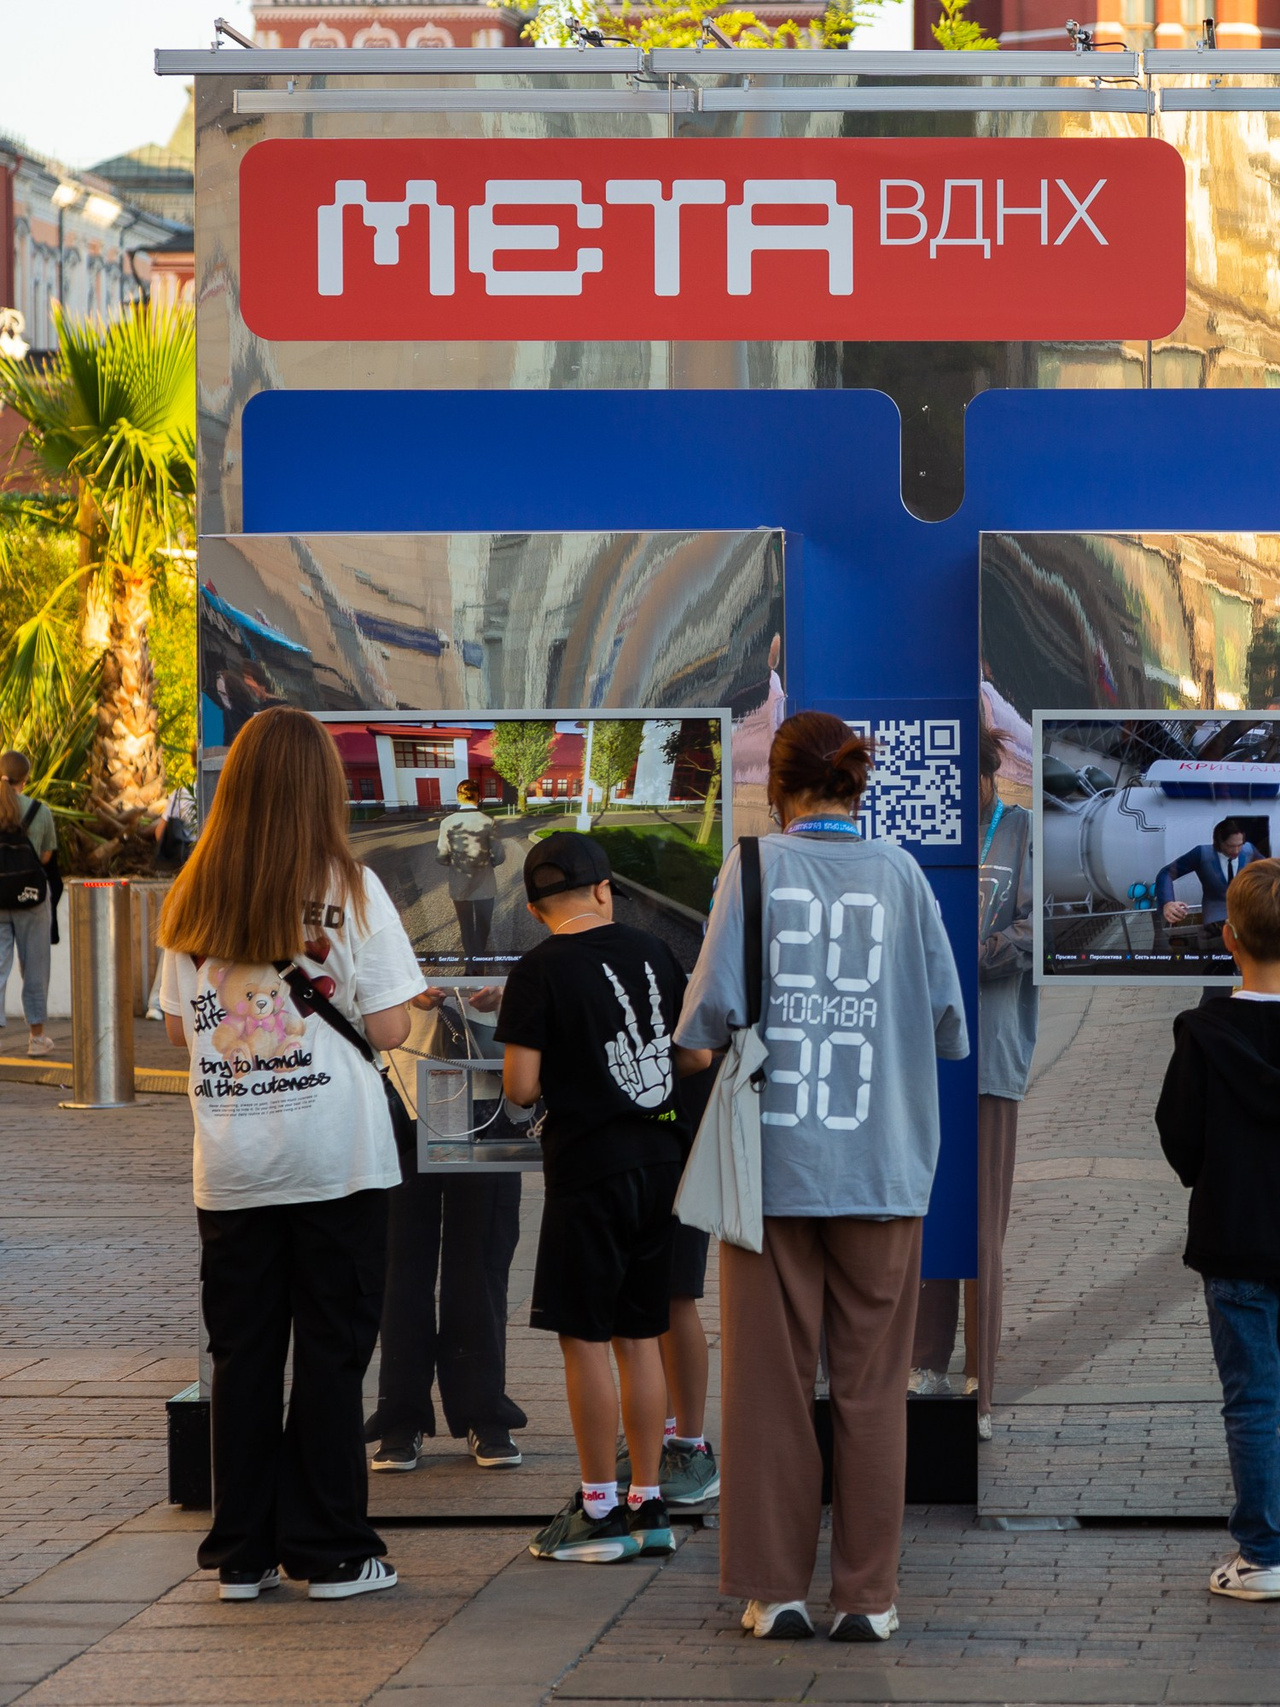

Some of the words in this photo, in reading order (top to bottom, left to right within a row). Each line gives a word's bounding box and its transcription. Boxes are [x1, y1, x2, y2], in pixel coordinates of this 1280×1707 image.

[317, 179, 854, 296] МЕТА
[879, 178, 1109, 259] ВДНХ
[769, 887, 885, 993] 20
[194, 1079, 214, 1098] all
[214, 1079, 248, 1098] this
[251, 1072, 331, 1096] cuteness
[199, 1057, 233, 1079] try
[233, 1056, 251, 1074] to
[254, 1049, 312, 1071] handle
[760, 1026, 874, 1131] 30
